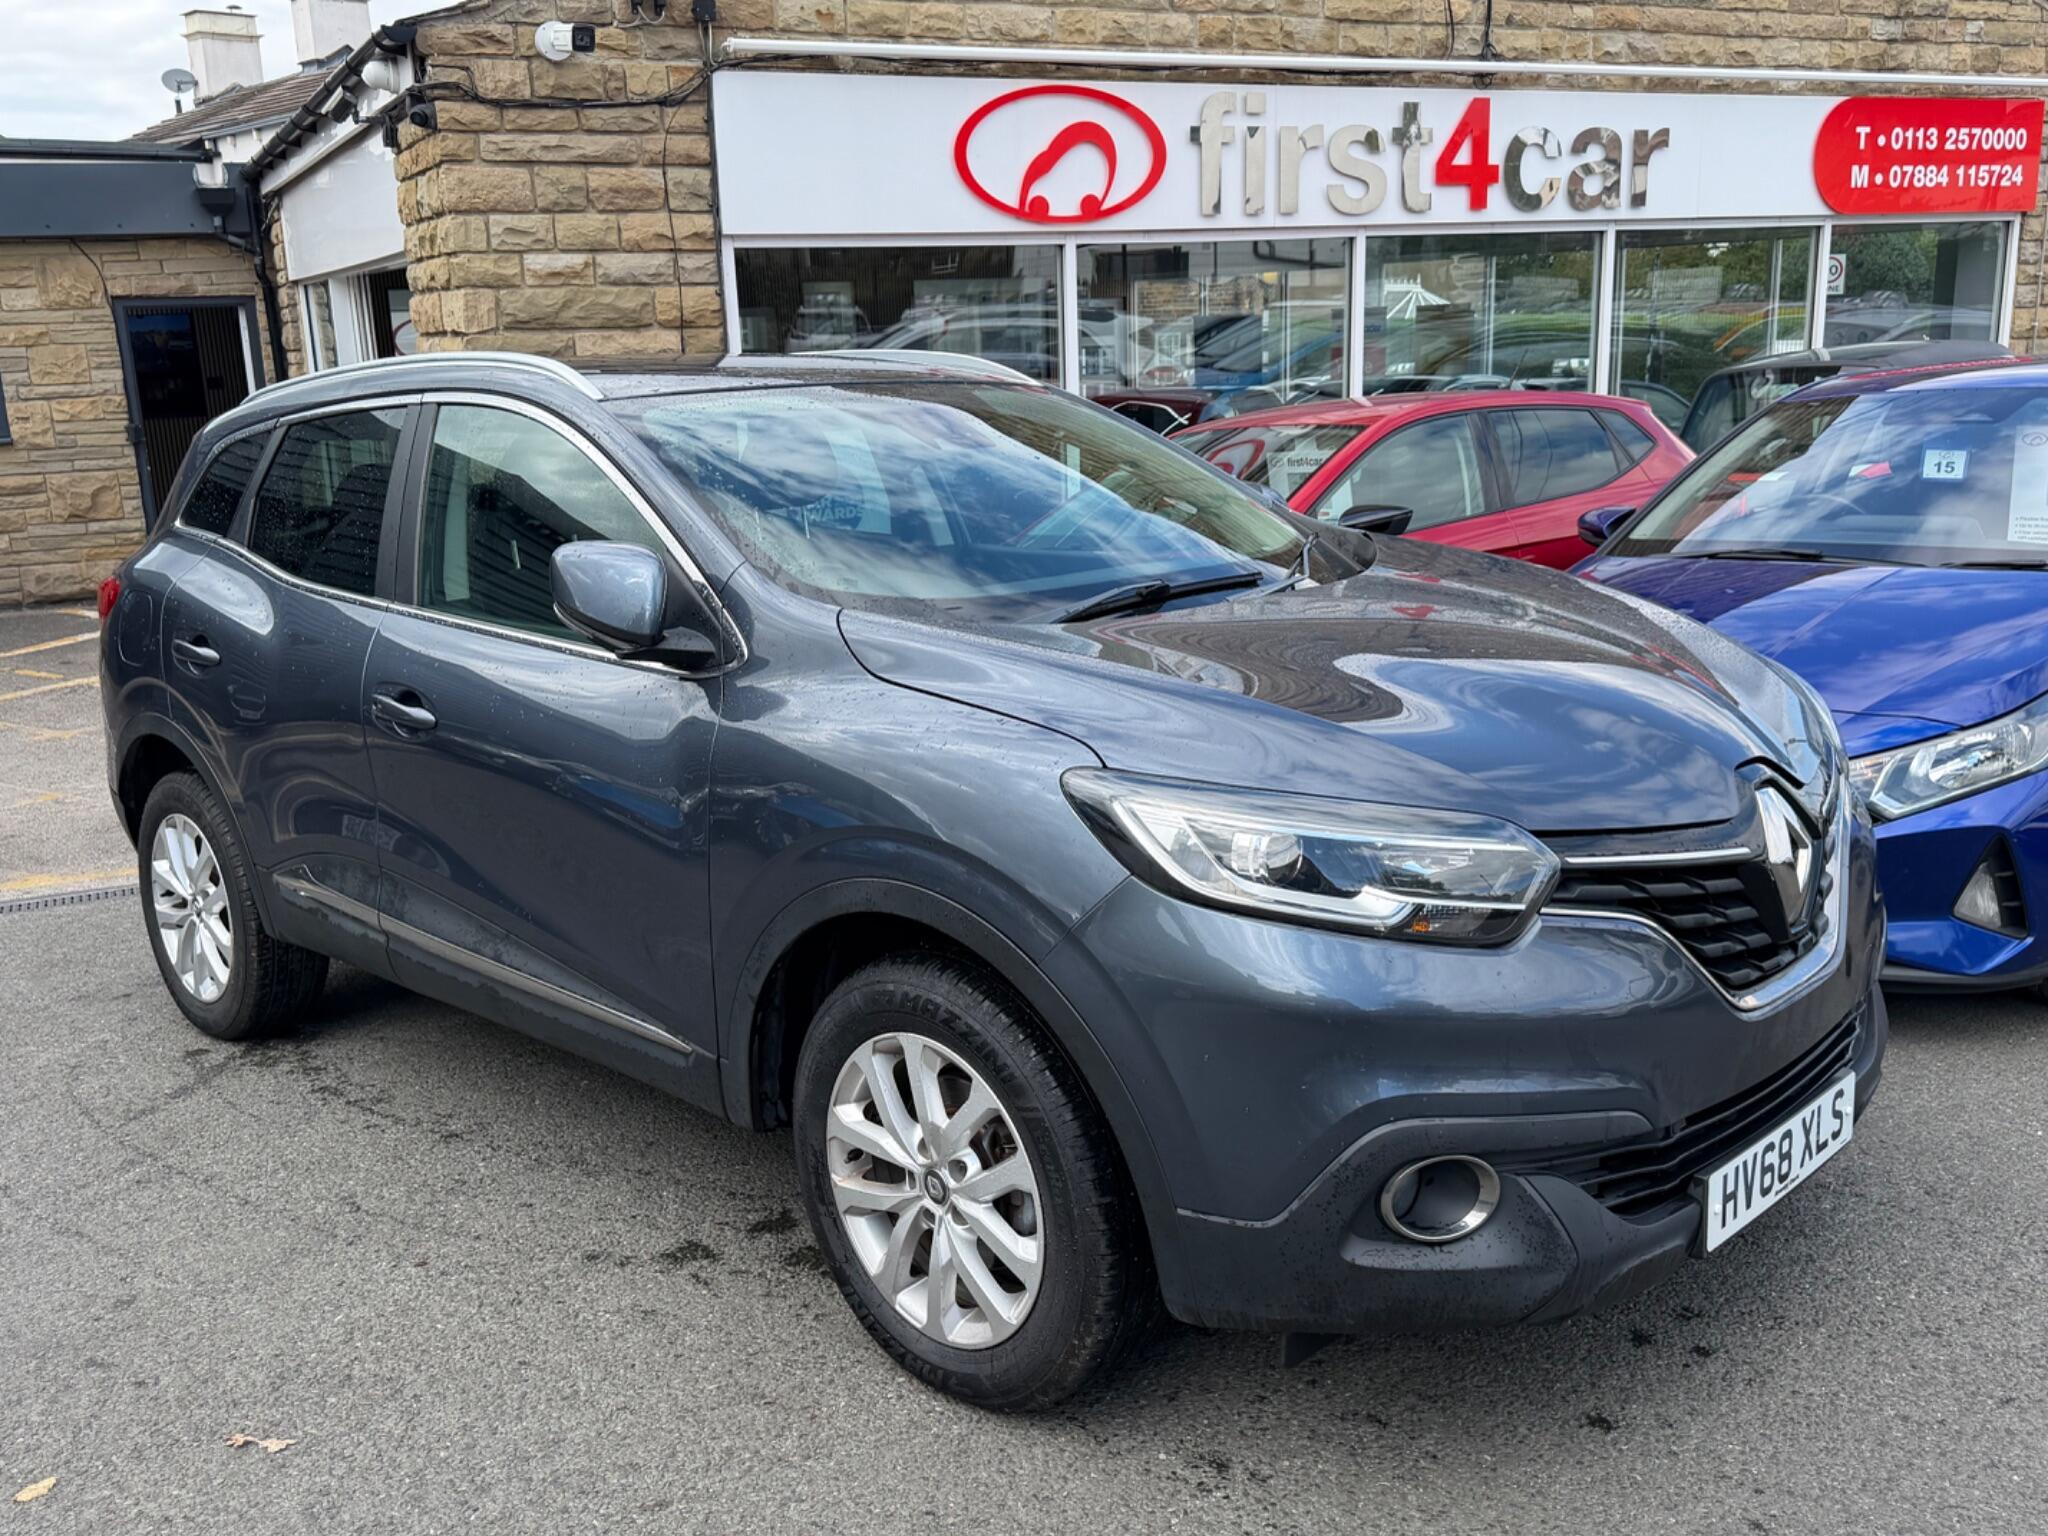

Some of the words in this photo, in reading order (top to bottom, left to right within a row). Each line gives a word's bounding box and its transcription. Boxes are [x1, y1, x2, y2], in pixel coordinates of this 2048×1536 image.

[1856, 126, 1871, 150] T
[1891, 127, 1938, 150] 0113
[1944, 127, 2027, 150] 2570000
[1190, 91, 1670, 216] first4car
[1851, 165, 1869, 188] M
[1889, 165, 1949, 188] 07884
[1956, 164, 2023, 187] 115724
[1934, 461, 1956, 474] 15
[1721, 1128, 1794, 1230] HV68
[1800, 1087, 1845, 1170] XLS
